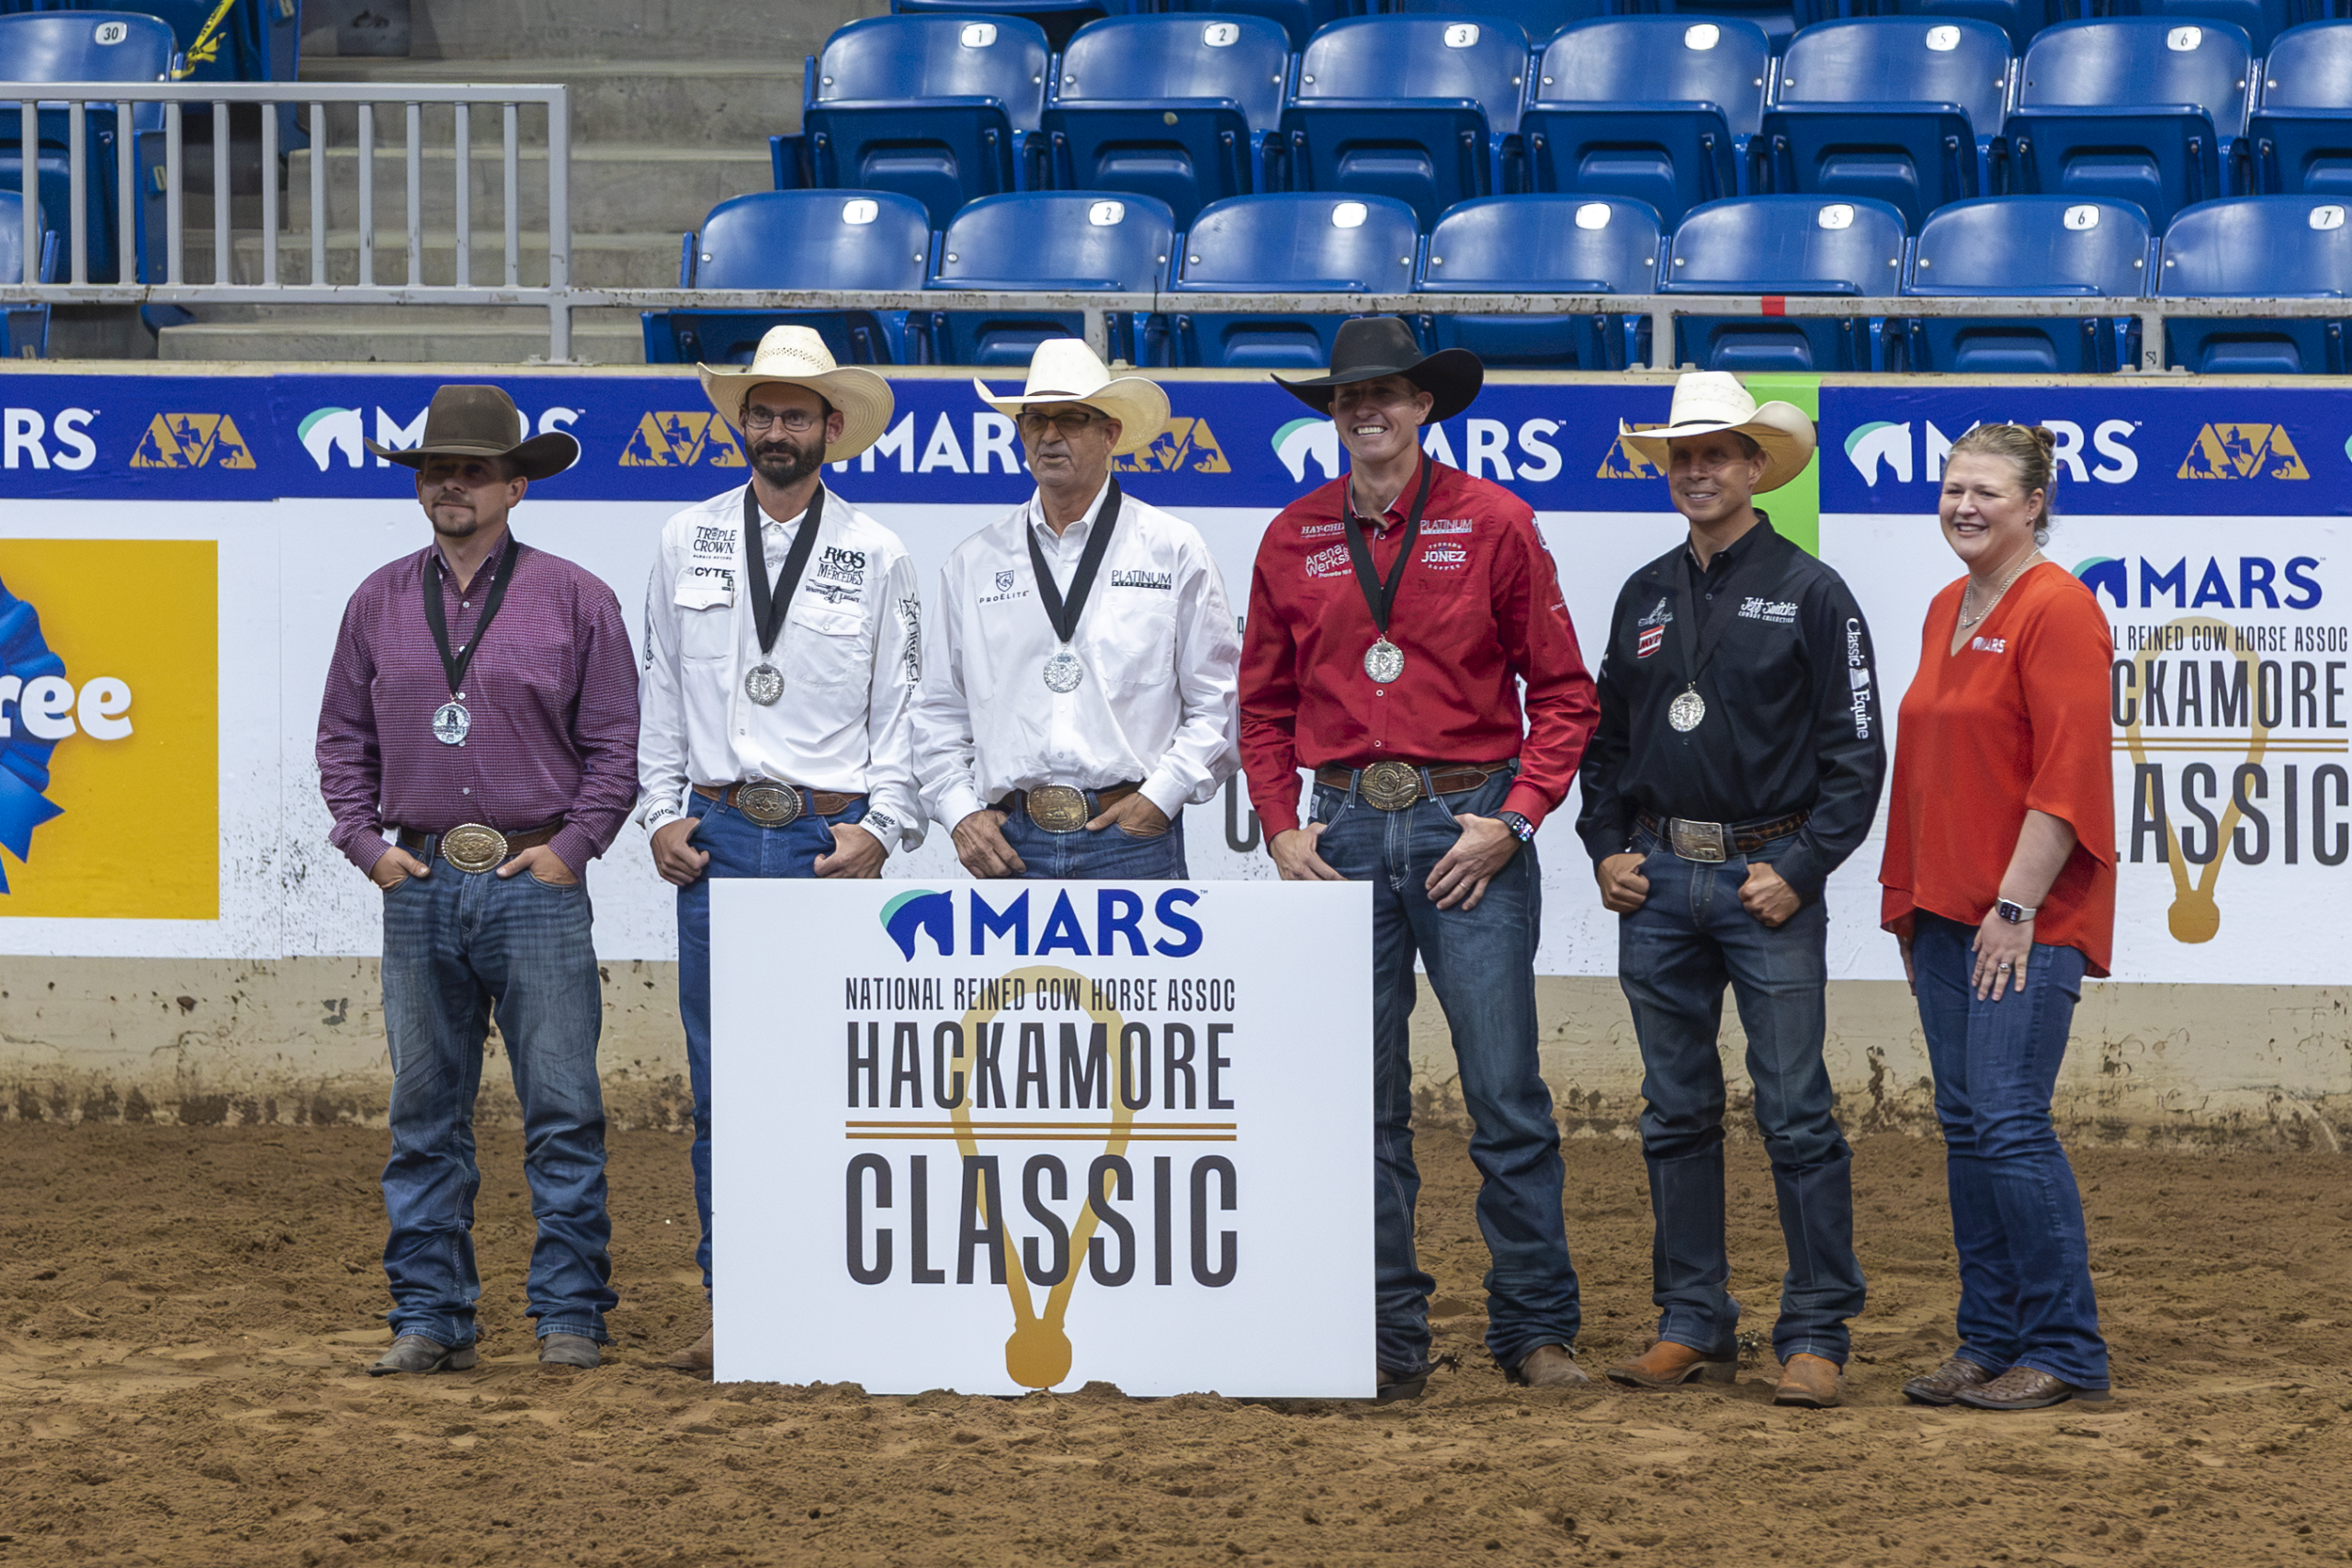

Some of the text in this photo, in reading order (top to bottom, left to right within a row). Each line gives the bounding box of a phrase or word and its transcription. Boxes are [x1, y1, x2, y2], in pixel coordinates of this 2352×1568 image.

[103, 26, 119, 41] 30
[1218, 28, 1228, 42] 2
[1458, 28, 1467, 43] 3
[1939, 32, 1947, 46] 5
[2180, 32, 2188, 47] 6
[1104, 207, 1113, 221] 2
[1831, 210, 1840, 225] 5
[2077, 209, 2086, 225] 6
[2323, 210, 2333, 225] 7
[4, 407, 96, 471] RS
[861, 411, 1032, 474] MAR
[1423, 418, 1563, 482] ARS
[1926, 419, 2139, 484] MRS
[1420, 519, 1473, 531] PLATINUM
[693, 539, 735, 554] CROWN
[1306, 544, 1343, 568] Arena
[1420, 551, 1467, 562] JONEZ
[820, 546, 865, 572] RIOS
[1306, 554, 1346, 578] Werks
[817, 563, 865, 585] MERCEDES
[1111, 570, 1172, 584] PLATINUM
[2140, 556, 2324, 611] MARS
[2128, 625, 2184, 652] REINED
[2192, 626, 2228, 652] COW
[2235, 626, 2288, 652] HORSE
[2294, 626, 2348, 652] ASSOC
[1846, 617, 1872, 739] Classic Equine
[2111, 659, 2348, 728] CKAMORE
[0, 674, 134, 740] ree
[2115, 761, 2350, 865] ASSIC
[970, 887, 1204, 958] MARS
[845, 976, 1236, 1012] NATIONAL REINED COW HORSE ASSOC
[846, 1021, 1236, 1111] HACKAMORE
[845, 1152, 1238, 1288] CLASSIC
